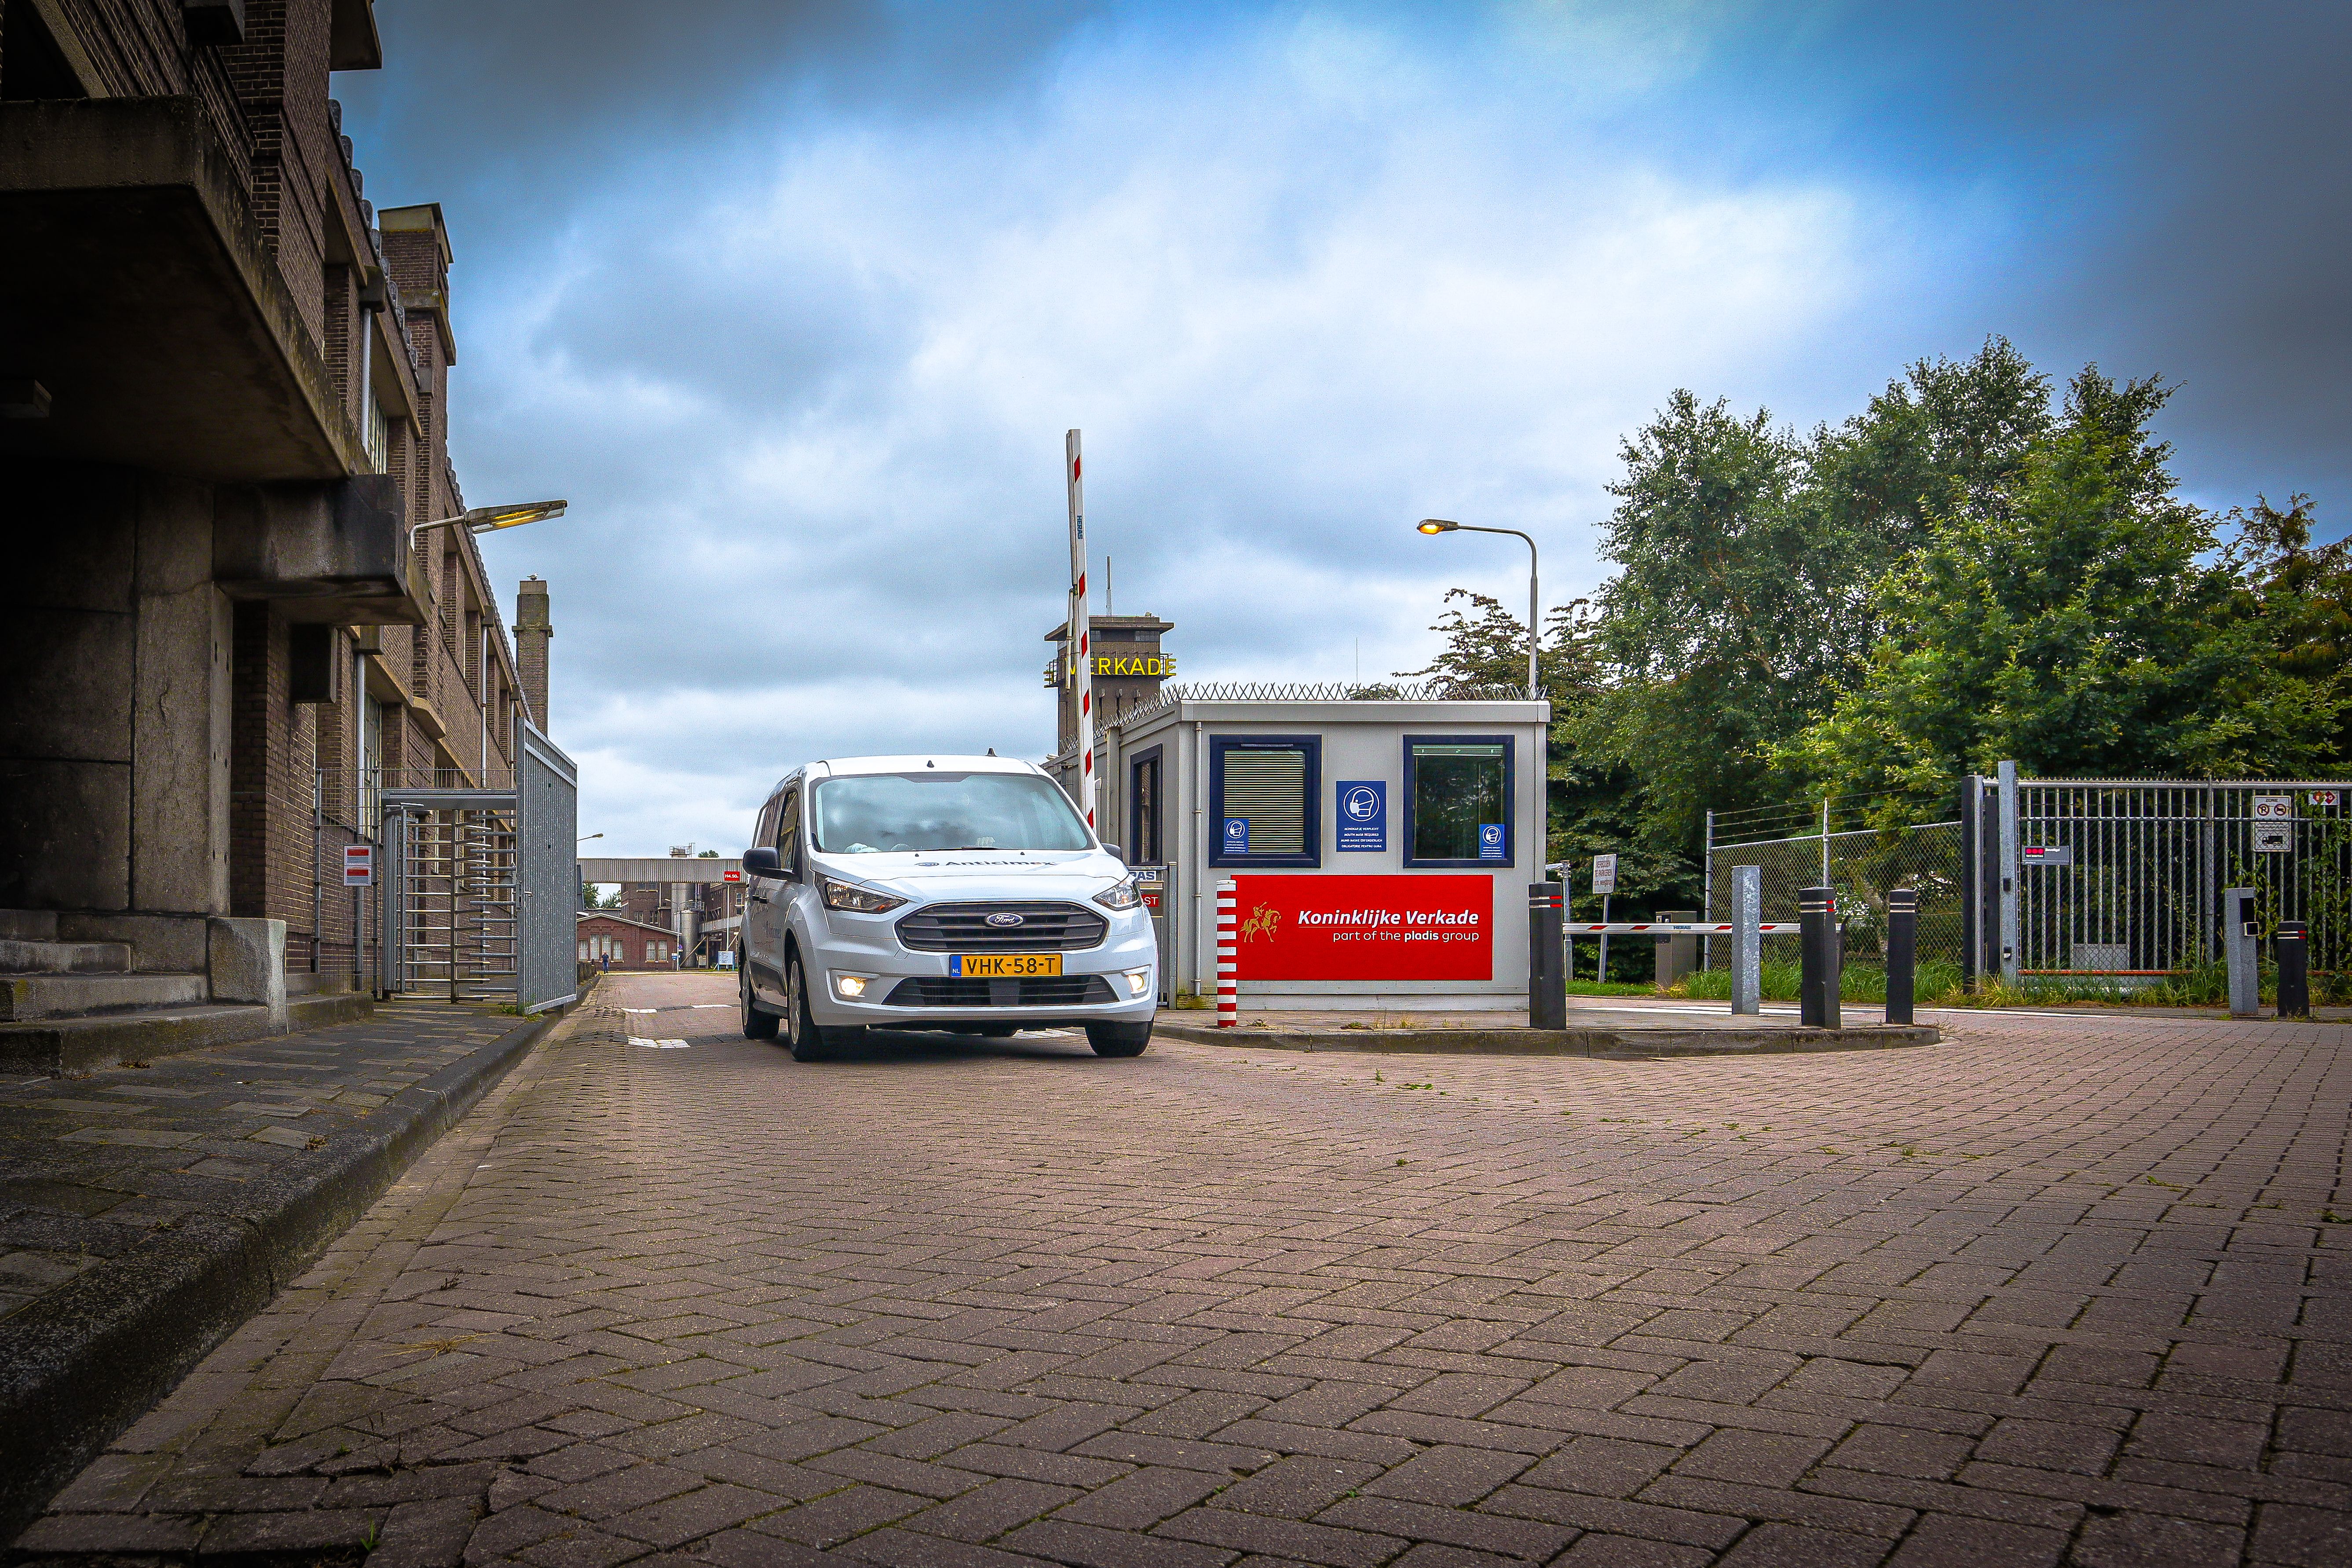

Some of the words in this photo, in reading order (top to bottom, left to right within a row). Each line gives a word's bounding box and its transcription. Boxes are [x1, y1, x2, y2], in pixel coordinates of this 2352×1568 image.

[1064, 658, 1177, 676] VRKADE
[994, 914, 1015, 924] Ford
[1299, 909, 1401, 928] Koninklijke
[1406, 909, 1479, 925] Verkade
[1333, 931, 1361, 943] part
[1363, 931, 1377, 940] of
[1379, 931, 1401, 940] the
[1405, 931, 1439, 943] pladis
[1442, 932, 1479, 943] group
[966, 957, 1056, 974] VHK-58-T
